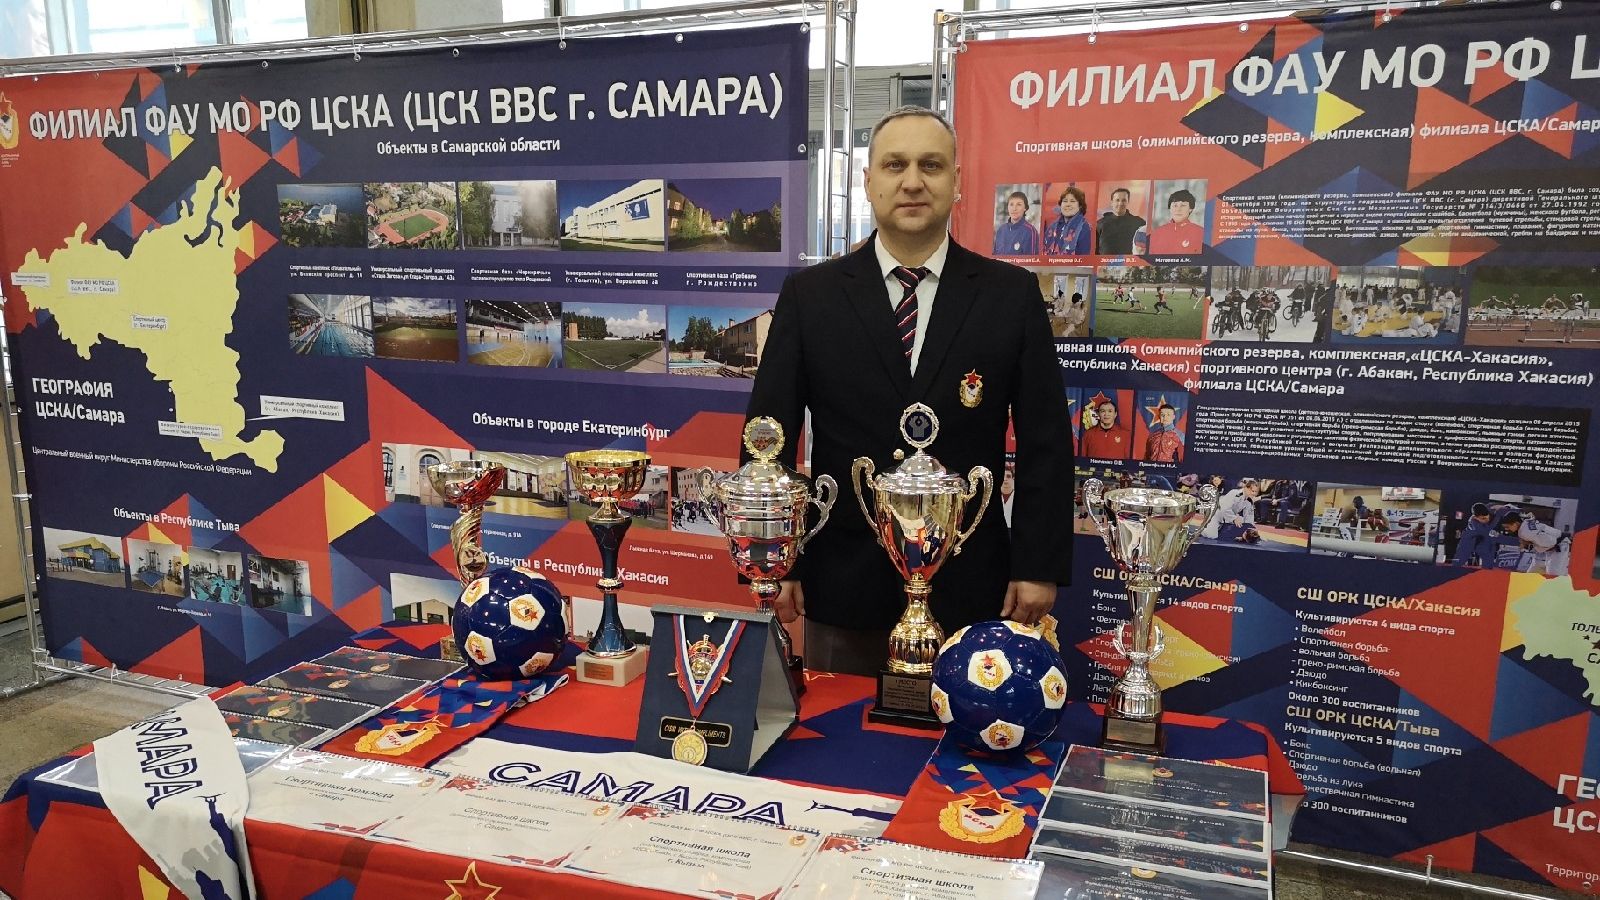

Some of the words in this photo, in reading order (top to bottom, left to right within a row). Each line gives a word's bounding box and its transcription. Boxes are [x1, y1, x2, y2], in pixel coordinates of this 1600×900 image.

[1010, 59, 1216, 109] ФИЛИАЛ
[1232, 50, 1347, 97] ФАУ
[1360, 44, 1446, 90] МО
[1464, 37, 1550, 85] РФ
[30, 107, 138, 140] ФИЛИАЛ
[145, 104, 199, 135] ФАУ
[209, 101, 251, 133] МО
[260, 99, 301, 131] РФ
[311, 94, 393, 136] ЦСКА
[403, 90, 481, 133] (ЦСК
[490, 86, 557, 124] ВВС
[568, 93, 595, 120] г.
[608, 73, 783, 120] САМАРА)
[377, 140, 428, 157] Объекты
[431, 144, 438, 153] в
[441, 138, 507, 156] Самарской
[510, 138, 560, 152] области
[862, 132, 868, 141] 6
[1015, 140, 1088, 154] Спортивная
[1092, 138, 1133, 150] школа
[1138, 133, 1238, 150] (олимпийского
[1242, 130, 1305, 149] резерва,
[1310, 124, 1415, 142] комплексная)
[1420, 122, 1489, 139] филиала
[1096, 344, 1136, 355] школа
[1141, 344, 1240, 358] (олимпийского
[1243, 348, 1305, 361] резерва,
[1131, 360, 1190, 373] Хакасия)
[1194, 363, 1278, 377] спортивного
[1282, 365, 1332, 380] центра
[1337, 365, 1352, 378] (г.
[1357, 366, 1418, 381] Абакан,
[1422, 368, 1514, 384] Республика
[1518, 371, 1594, 386] Хакасия)
[32, 378, 113, 399] ГЕОГРАФИЯ
[1184, 379, 1241, 392] филиала
[1245, 379, 1345, 397] ЦСКА/Самара
[36, 401, 125, 426] ЦСКА/Самара
[473, 412, 525, 429] Объекты
[527, 419, 534, 429] в
[537, 419, 579, 435] городе
[582, 420, 670, 440] Екатеринбург
[32, 446, 68, 458] Центральный
[69, 450, 93, 460] военный
[110, 455, 151, 466] Министерства
[179, 460, 214, 472] Российской
[216, 464, 252, 476] Федерации
[113, 507, 152, 524] Объекты
[154, 514, 159, 523] в
[161, 512, 214, 532] Республике
[215, 518, 240, 532] Тыва
[484, 551, 531, 568] бъекты
[534, 560, 540, 569] в
[545, 559, 604, 578] Республи
[617, 567, 669, 585] Хакасия
[1094, 568, 1115, 580] СШ
[1097, 604, 1116, 612] Бокс
[1168, 597, 1178, 605] 14
[1182, 601, 1210, 609] видов
[1212, 603, 1243, 614] спорта
[1297, 587, 1322, 601] СШ
[1327, 590, 1358, 605] ОРК
[1364, 593, 1481, 617] ЦСКА/Хакасия
[1296, 610, 1378, 627] Культивируются
[1381, 619, 1387, 628] 4
[1390, 622, 1416, 632] вида
[1419, 624, 1455, 635] спорта
[1301, 624, 1346, 638] Волейбол
[1300, 636, 1353, 649] Спортивная
[1299, 649, 1335, 659] вольная
[1338, 652, 1370, 662] борьба
[1296, 669, 1327, 680] Дзюдо
[1298, 659, 1365, 674] греко-римская
[1368, 666, 1400, 677] борьба
[1296, 680, 1348, 693] Кикбоксинг
[1289, 692, 1319, 703] Около
[1322, 696, 1340, 706] 300
[1342, 701, 1420, 717] воспитанников
[1287, 705, 1311, 718] СШ
[1315, 709, 1346, 724] ОРК
[1351, 714, 1440, 737] ЦСКА/Тыва
[1285, 722, 1373, 743] Культивируются
[1376, 736, 1383, 745] 5
[1386, 738, 1420, 750] видов
[1424, 743, 1462, 756] спорта
[1290, 739, 1311, 749] Бокс
[1289, 750, 1340, 765] Спортивная
[1343, 759, 1375, 770] борьба
[1377, 764, 1421, 777] (вольная)
[1289, 760, 1318, 771] Дзюдо
[488, 762, 785, 826] САМАРА
[1342, 780, 1363, 788] лука
[1557, 774, 1600, 799] ГЕ
[1311, 801, 1329, 811] 300
[1332, 806, 1408, 824] воспитанников
[1362, 793, 1415, 809] гимнастика
[463, 807, 518, 822] Спортивная
[519, 817, 550, 826] школа
[1553, 807, 1600, 833] ЦС
[649, 835, 713, 853] Спортивная
[717, 848, 751, 858] школа
[860, 866, 933, 885] Спортивная
[935, 880, 974, 890] школа
